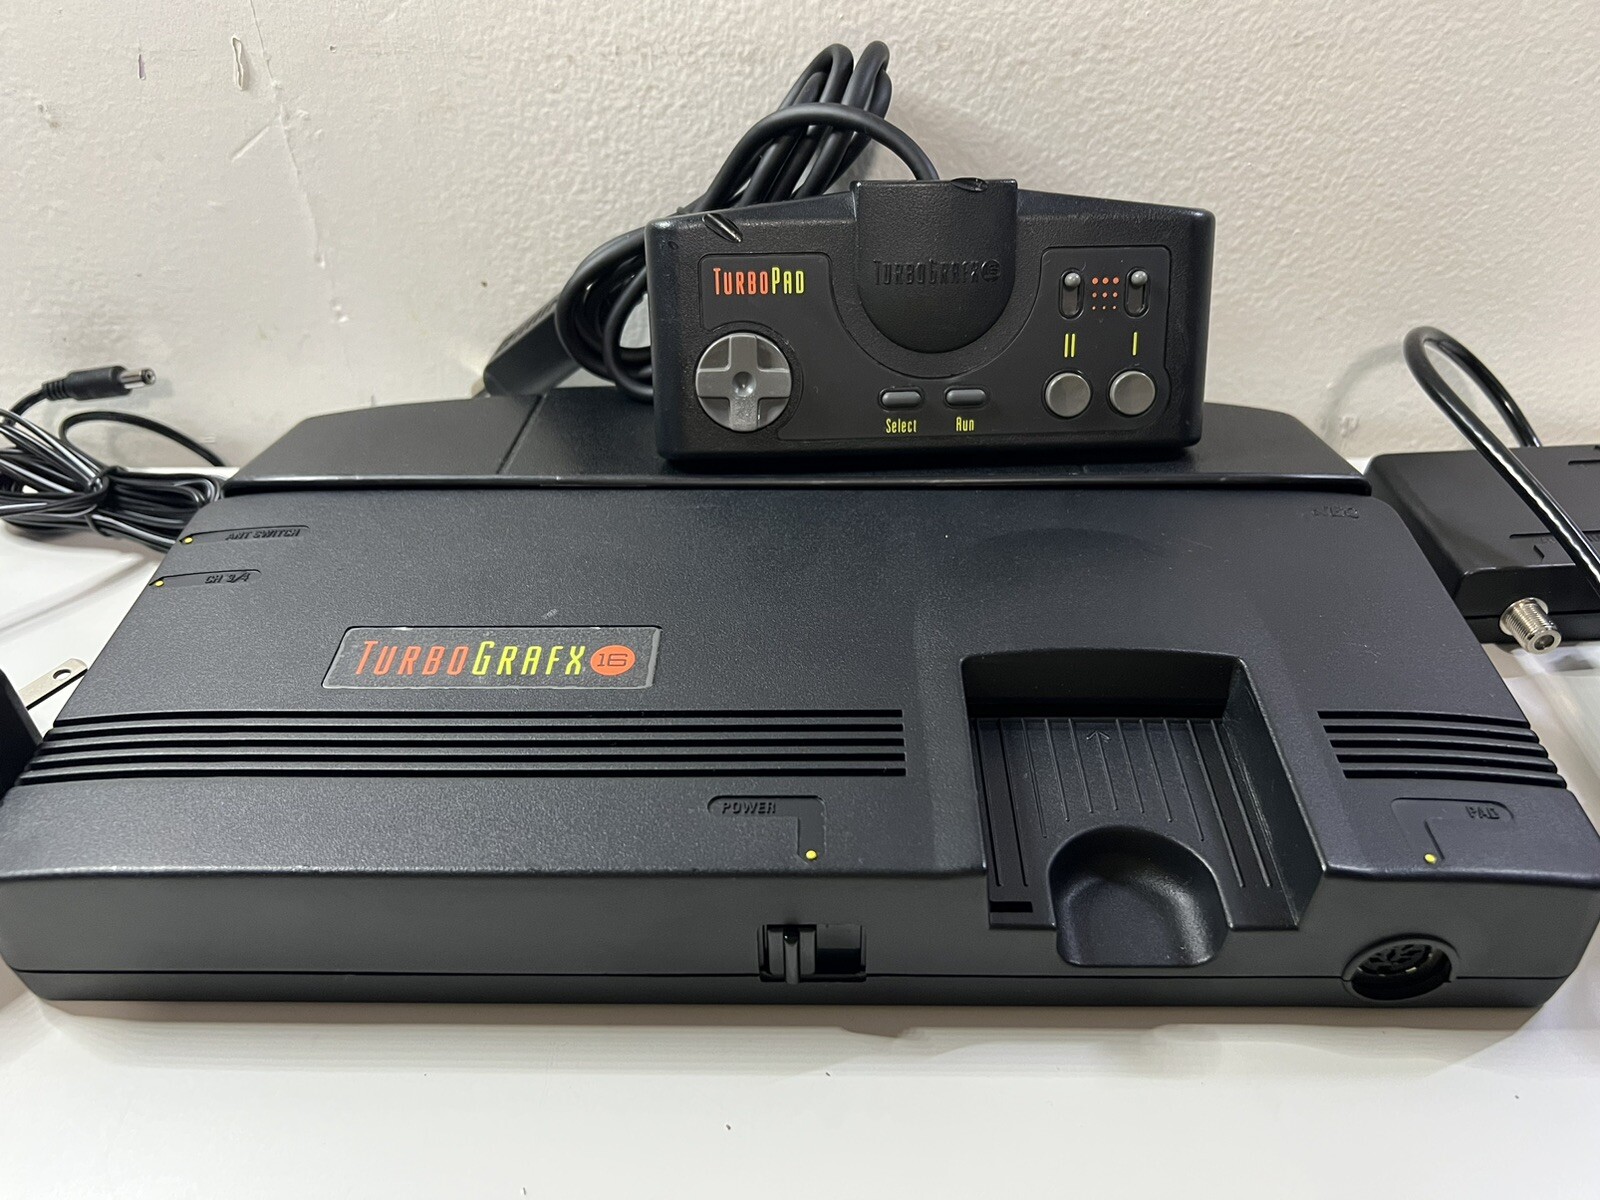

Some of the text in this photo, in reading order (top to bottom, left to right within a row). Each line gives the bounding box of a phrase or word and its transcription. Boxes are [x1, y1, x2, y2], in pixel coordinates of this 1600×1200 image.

[885, 417, 918, 434] Select
[955, 416, 976, 432] Run
[225, 528, 301, 541] ANT SWITCH
[204, 572, 251, 584] CH 3/4
[721, 801, 777, 814] POWER
[1464, 805, 1500, 819] PAD
